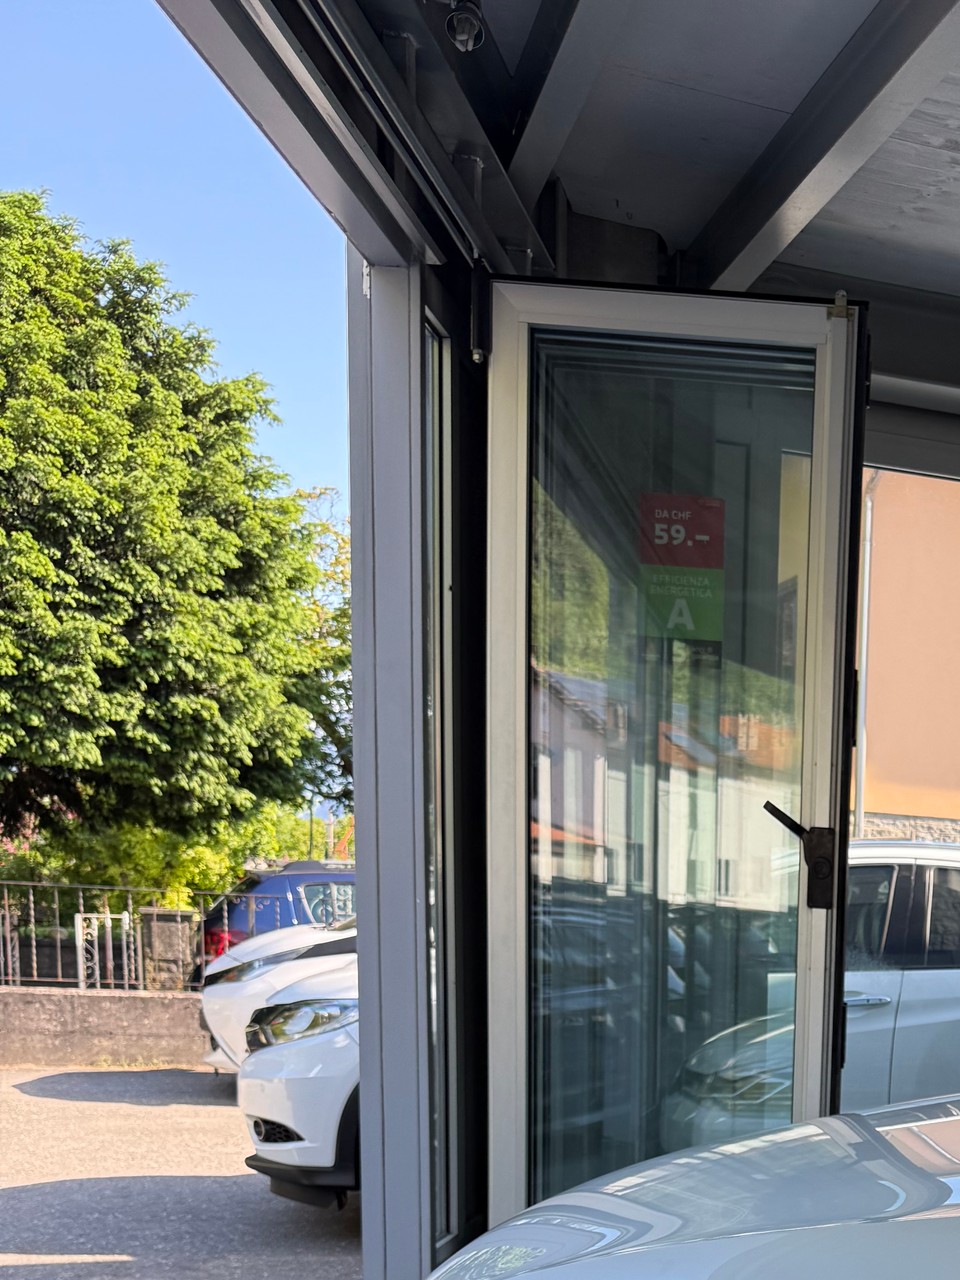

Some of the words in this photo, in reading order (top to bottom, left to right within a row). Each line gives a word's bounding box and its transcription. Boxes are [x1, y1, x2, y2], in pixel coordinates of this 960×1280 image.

[655, 509, 669, 519] DA
[671, 510, 692, 521] CHF
[654, 523, 710, 547] 59.-
[653, 574, 711, 586] EFFICIENZA
[650, 585, 713, 599] ENERGETICA
[666, 598, 695, 631] A
